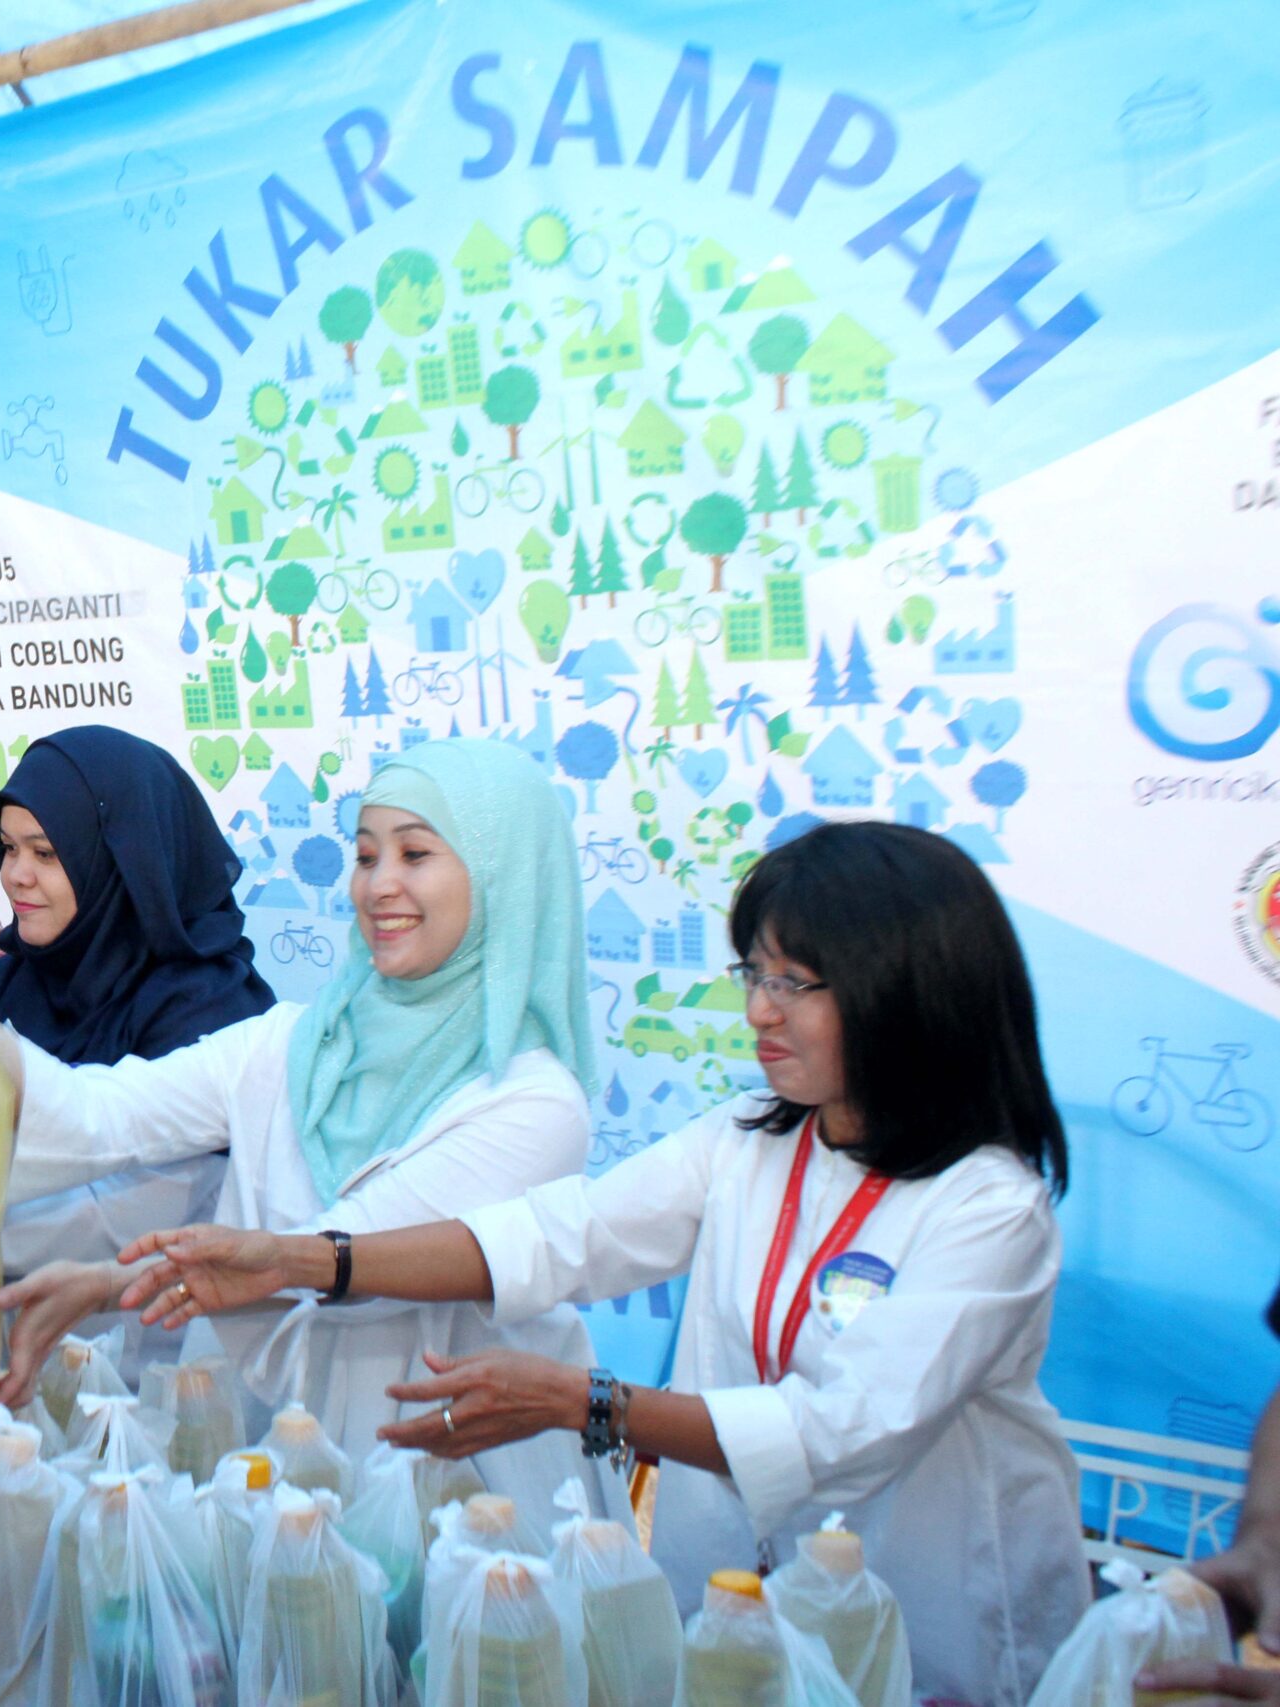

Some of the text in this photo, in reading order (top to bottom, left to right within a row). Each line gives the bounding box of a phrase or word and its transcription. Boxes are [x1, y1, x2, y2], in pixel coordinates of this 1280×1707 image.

[106, 39, 1102, 483] TUKAR SAMPAH
[10, 636, 125, 667] COBLONG
[11, 680, 133, 710] BANDUNG
